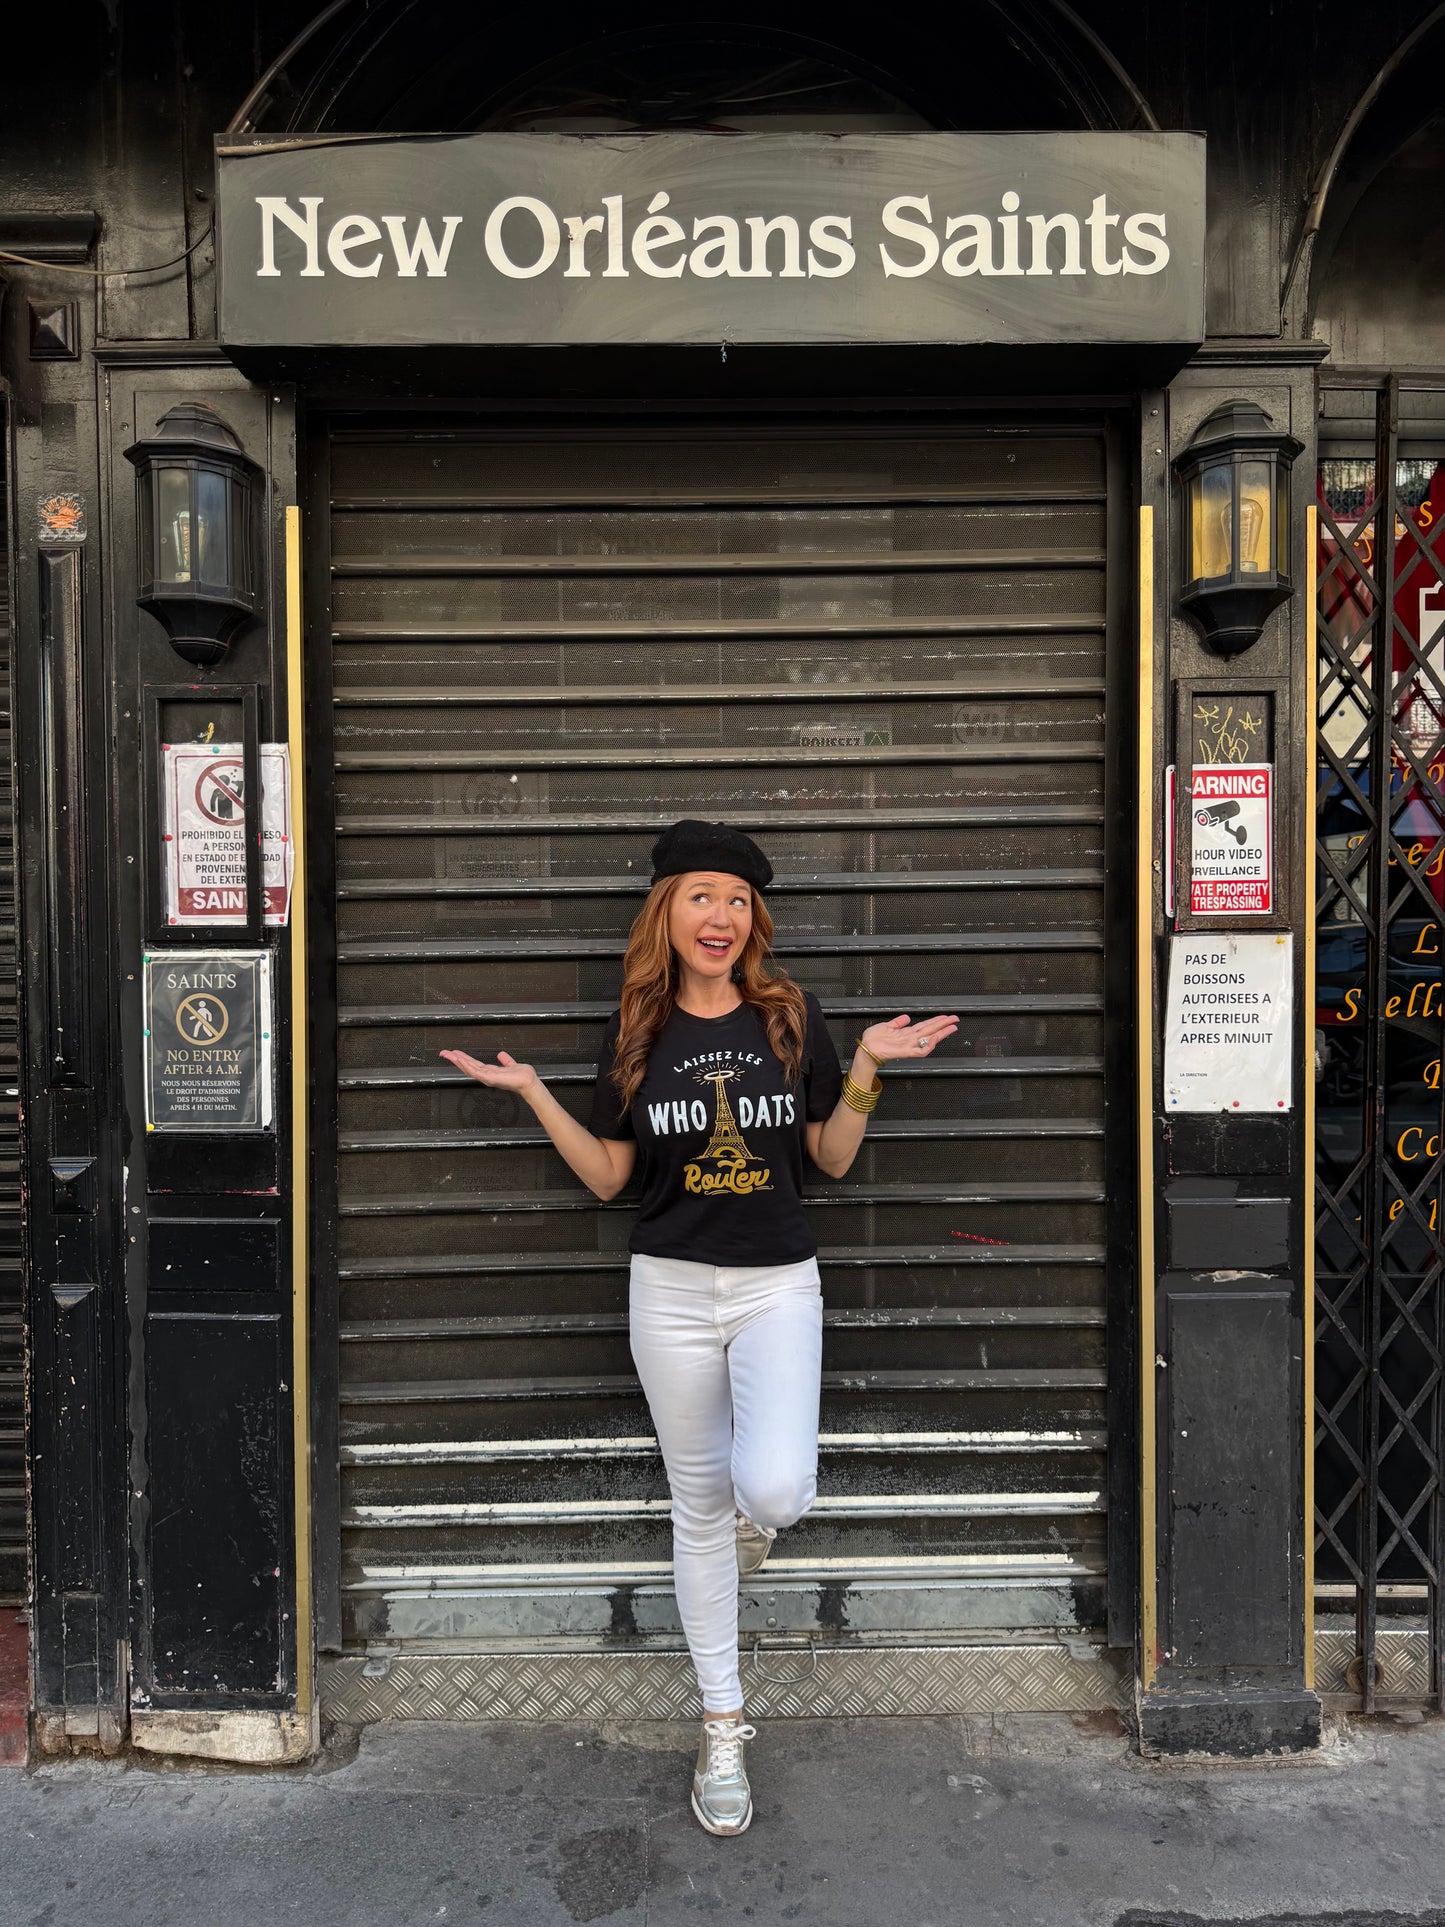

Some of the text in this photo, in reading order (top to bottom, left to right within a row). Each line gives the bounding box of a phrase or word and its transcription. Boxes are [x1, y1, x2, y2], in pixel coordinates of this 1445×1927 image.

[255, 191, 1171, 279] New Orléans Saints
[1192, 775, 1266, 795] ARNING
[182, 830, 230, 840] PROHIBIDO
[233, 830, 244, 839] EL
[203, 842, 247, 851] A PERSON
[182, 854, 193, 862] EN
[195, 854, 226, 862] ESTADO
[228, 854, 239, 862] DE
[1195, 848, 1262, 861] HOUR VIDEO
[196, 864, 247, 873] PROVENIEN
[1192, 866, 1261, 876] RVEILLANCE
[201, 875, 247, 884] DEL EXTER
[1216, 882, 1269, 896] PROPERTY
[193, 890, 272, 909] SAINS
[1194, 896, 1262, 909] TRESPASSING
[1185, 954, 1227, 965] PAS DE
[167, 974, 237, 989] SAINTS
[1183, 974, 1245, 985] BOISSONS
[1182, 993, 1272, 1004] AUTORISEES A
[1180, 1033, 1273, 1044] APRES MINUIT
[167, 1050, 241, 1062] NO ENTRY
[673, 1051, 763, 1073] LAISSEZ LES
[164, 1064, 242, 1075] AFTER 4 A.M.
[202, 1079, 241, 1087] RÉSERVONS
[647, 1093, 796, 1136] WHO DATS
